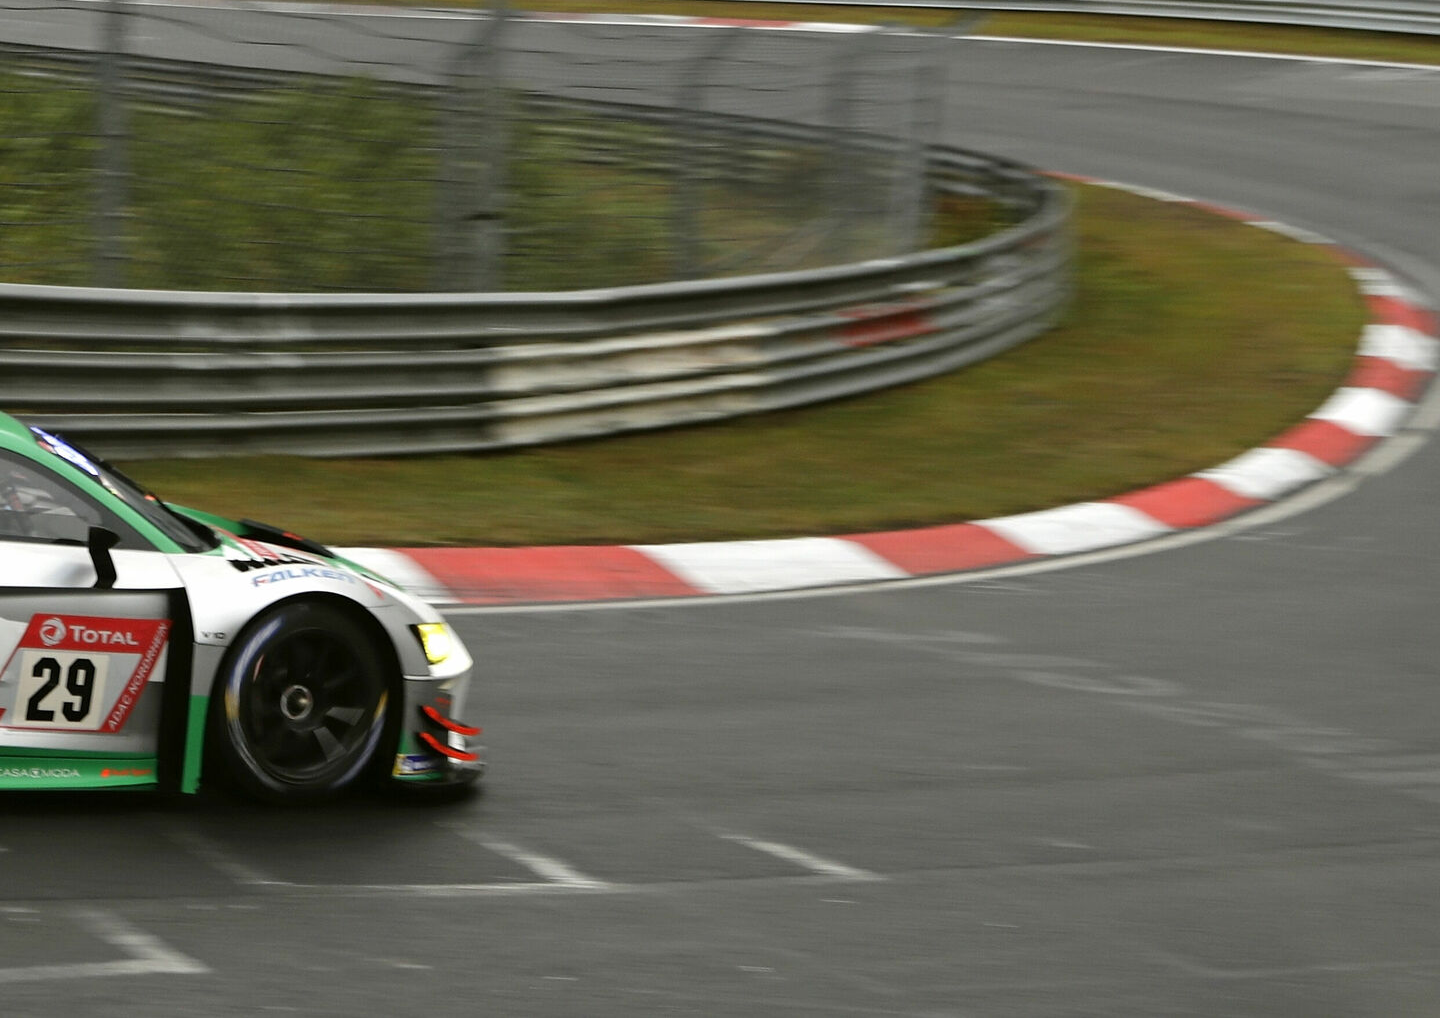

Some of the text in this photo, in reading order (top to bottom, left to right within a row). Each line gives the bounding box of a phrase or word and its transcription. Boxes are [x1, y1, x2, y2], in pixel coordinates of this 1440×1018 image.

[252, 568, 356, 587] FALKEN
[69, 625, 139, 645] TOTAL
[25, 657, 95, 722] 29
[109, 694, 133, 730] ADAC
